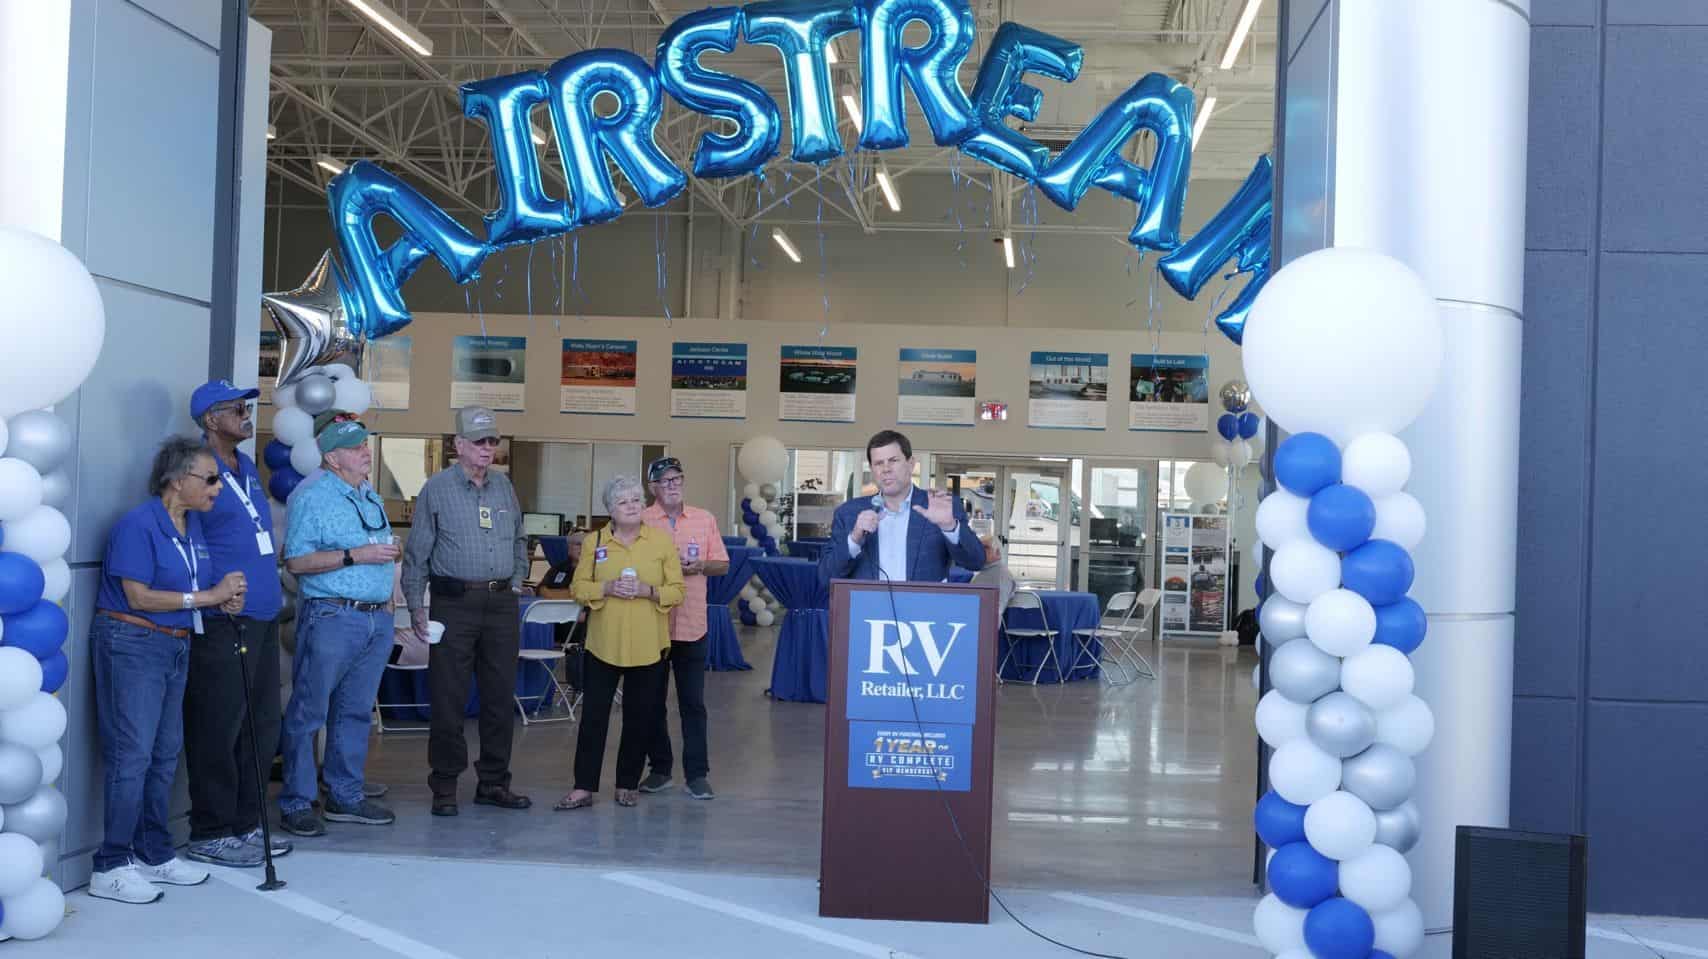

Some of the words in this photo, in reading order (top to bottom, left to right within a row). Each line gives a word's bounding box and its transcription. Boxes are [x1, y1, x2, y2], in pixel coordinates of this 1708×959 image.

[862, 619, 967, 677] RV
[861, 680, 924, 701] Retailer,
[926, 683, 965, 700] LLC
[874, 736, 884, 753] 1
[886, 738, 937, 756] YEAR
[869, 755, 883, 765] RV
[890, 755, 951, 767] COMPLETE
